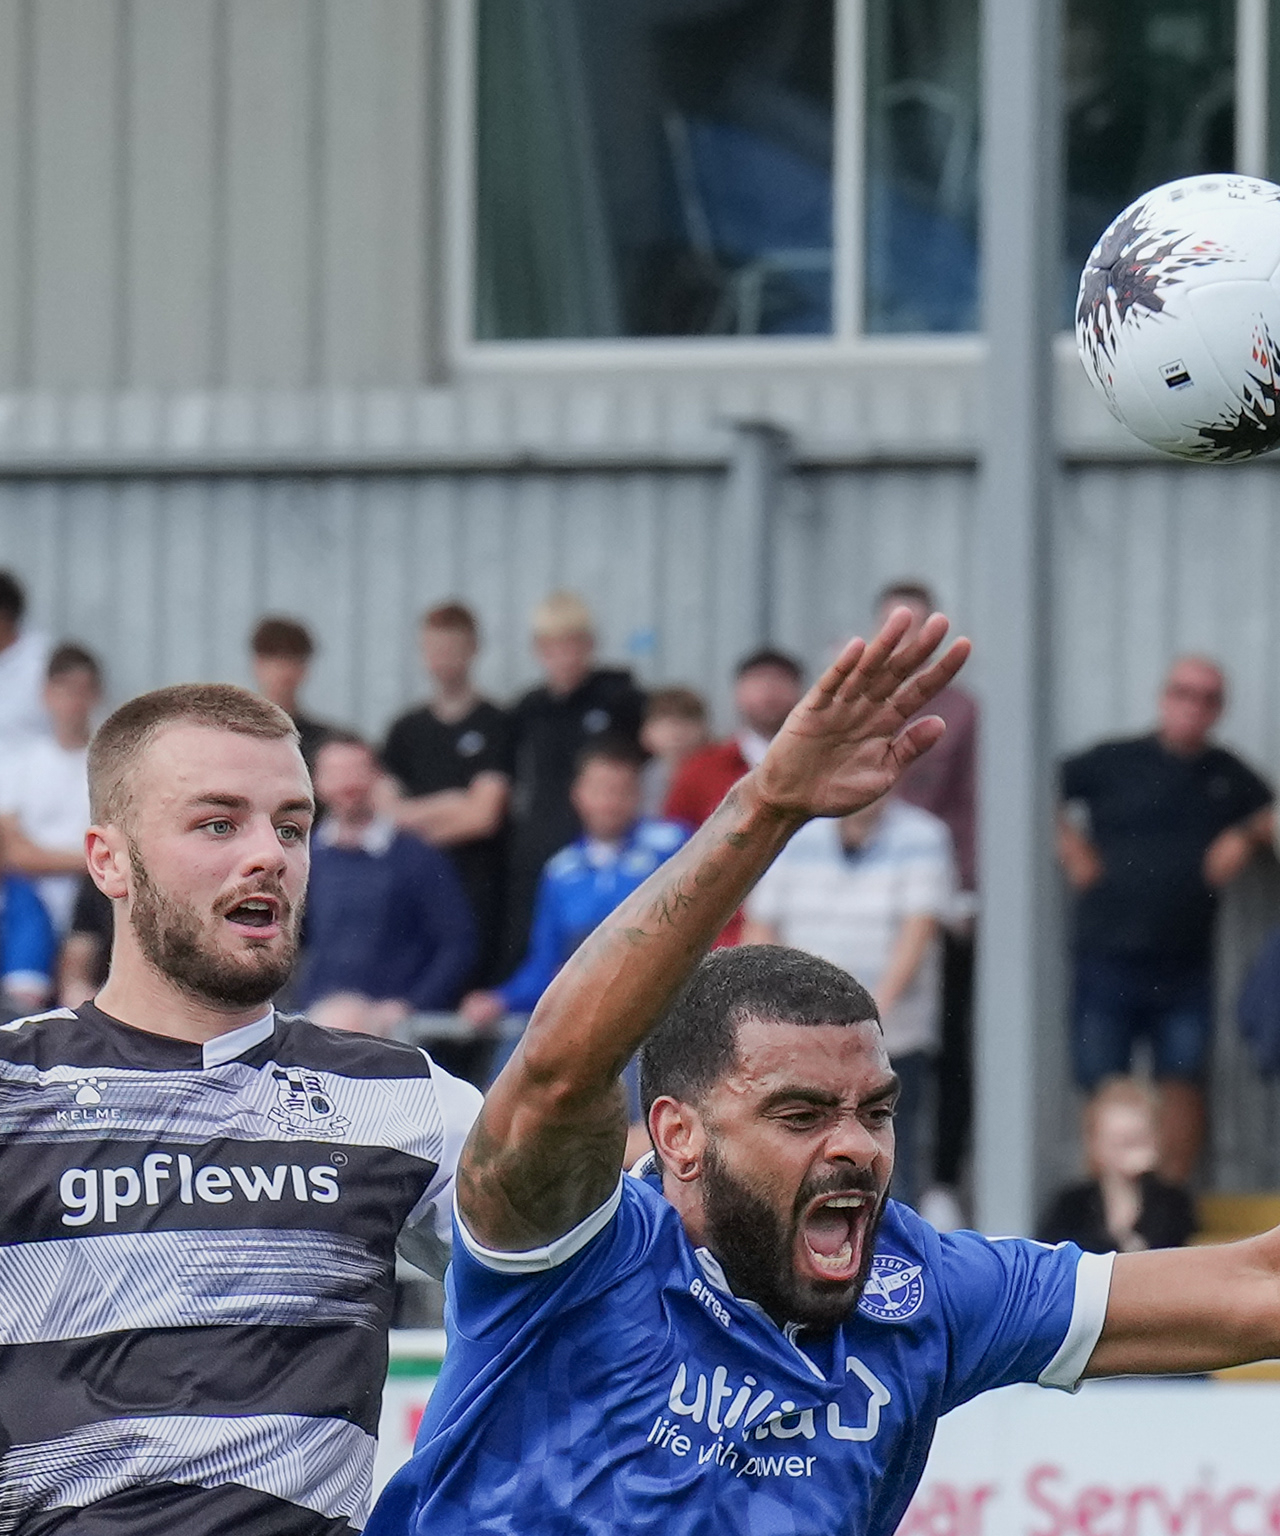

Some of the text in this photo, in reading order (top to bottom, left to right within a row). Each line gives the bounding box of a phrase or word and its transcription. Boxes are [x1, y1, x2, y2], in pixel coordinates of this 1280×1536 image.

[56, 1108, 121, 1121] KELME
[59, 1153, 340, 1227] gpflewis
[647, 1416, 692, 1457] life
